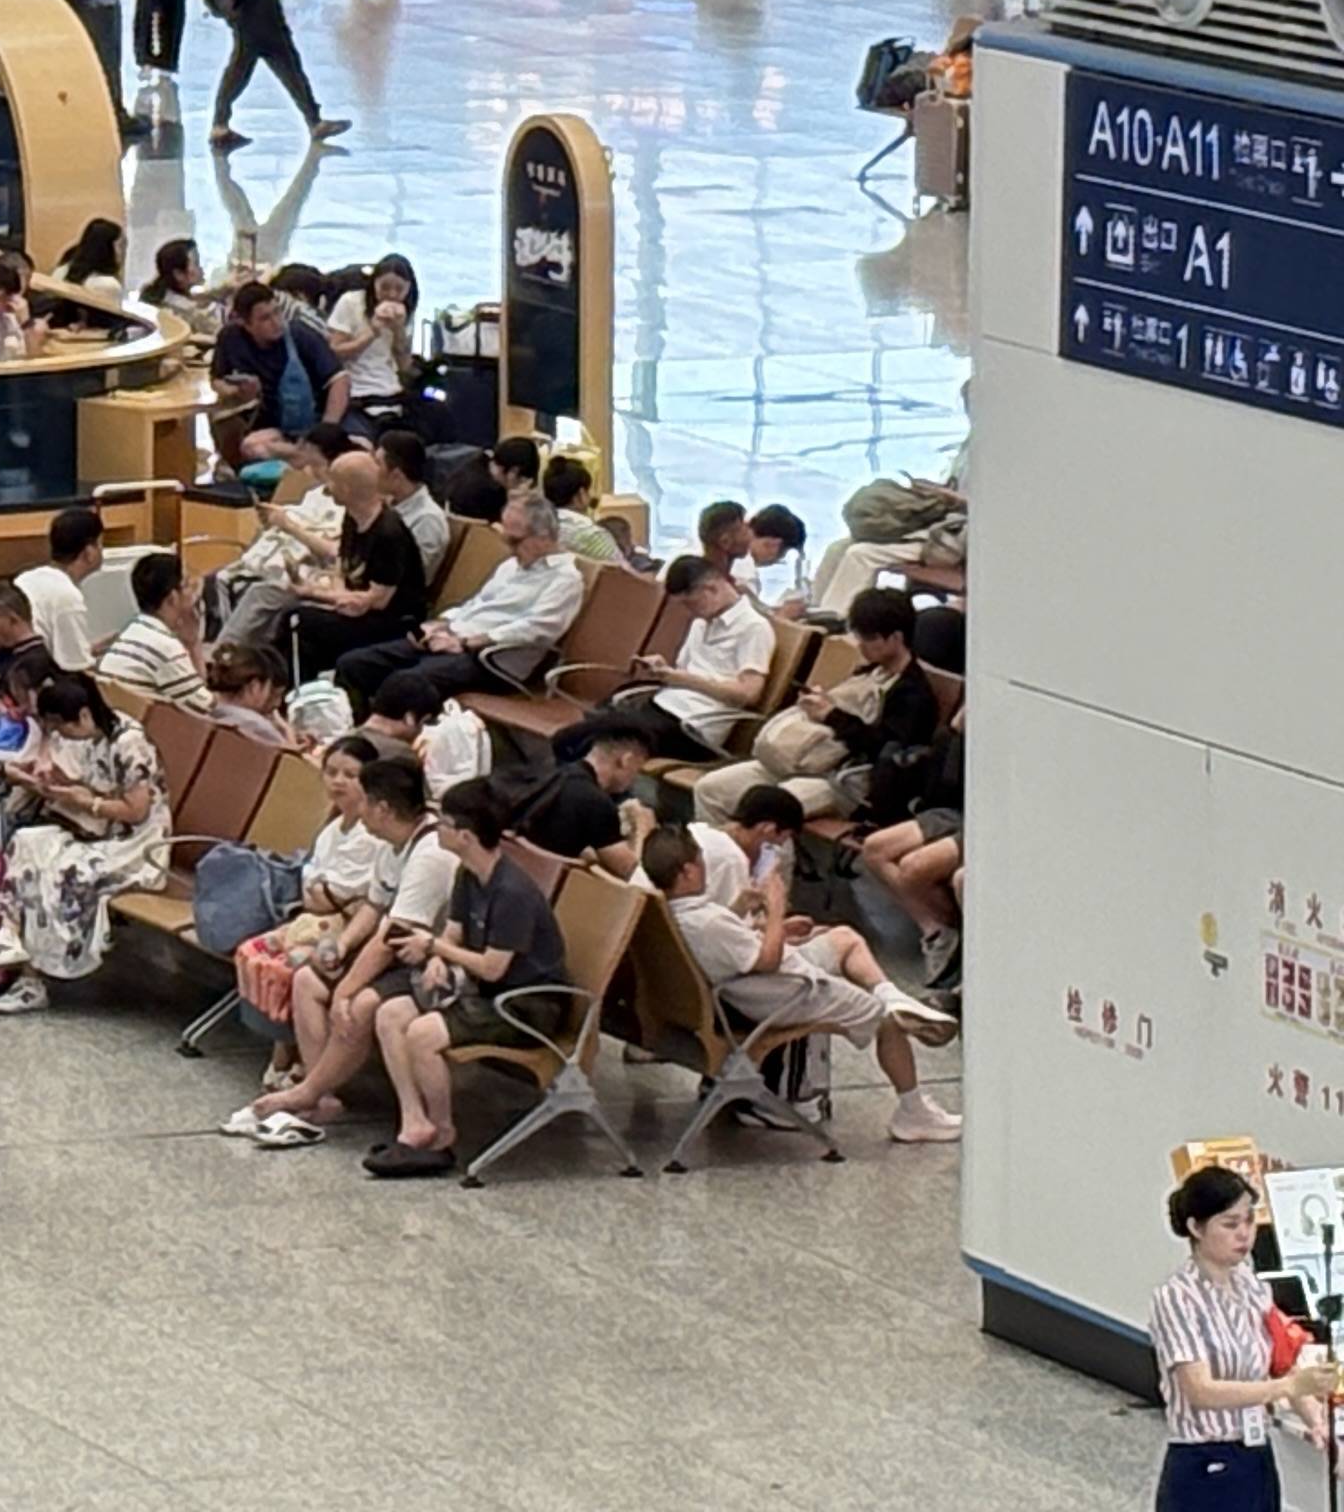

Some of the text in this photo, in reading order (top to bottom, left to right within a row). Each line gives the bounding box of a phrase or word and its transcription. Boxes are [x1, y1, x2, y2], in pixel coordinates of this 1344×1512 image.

[1141, 214, 1232, 290] 出口 A1
[1177, 323, 1190, 369] 1
[1067, 985, 1152, 1049] 检修门
